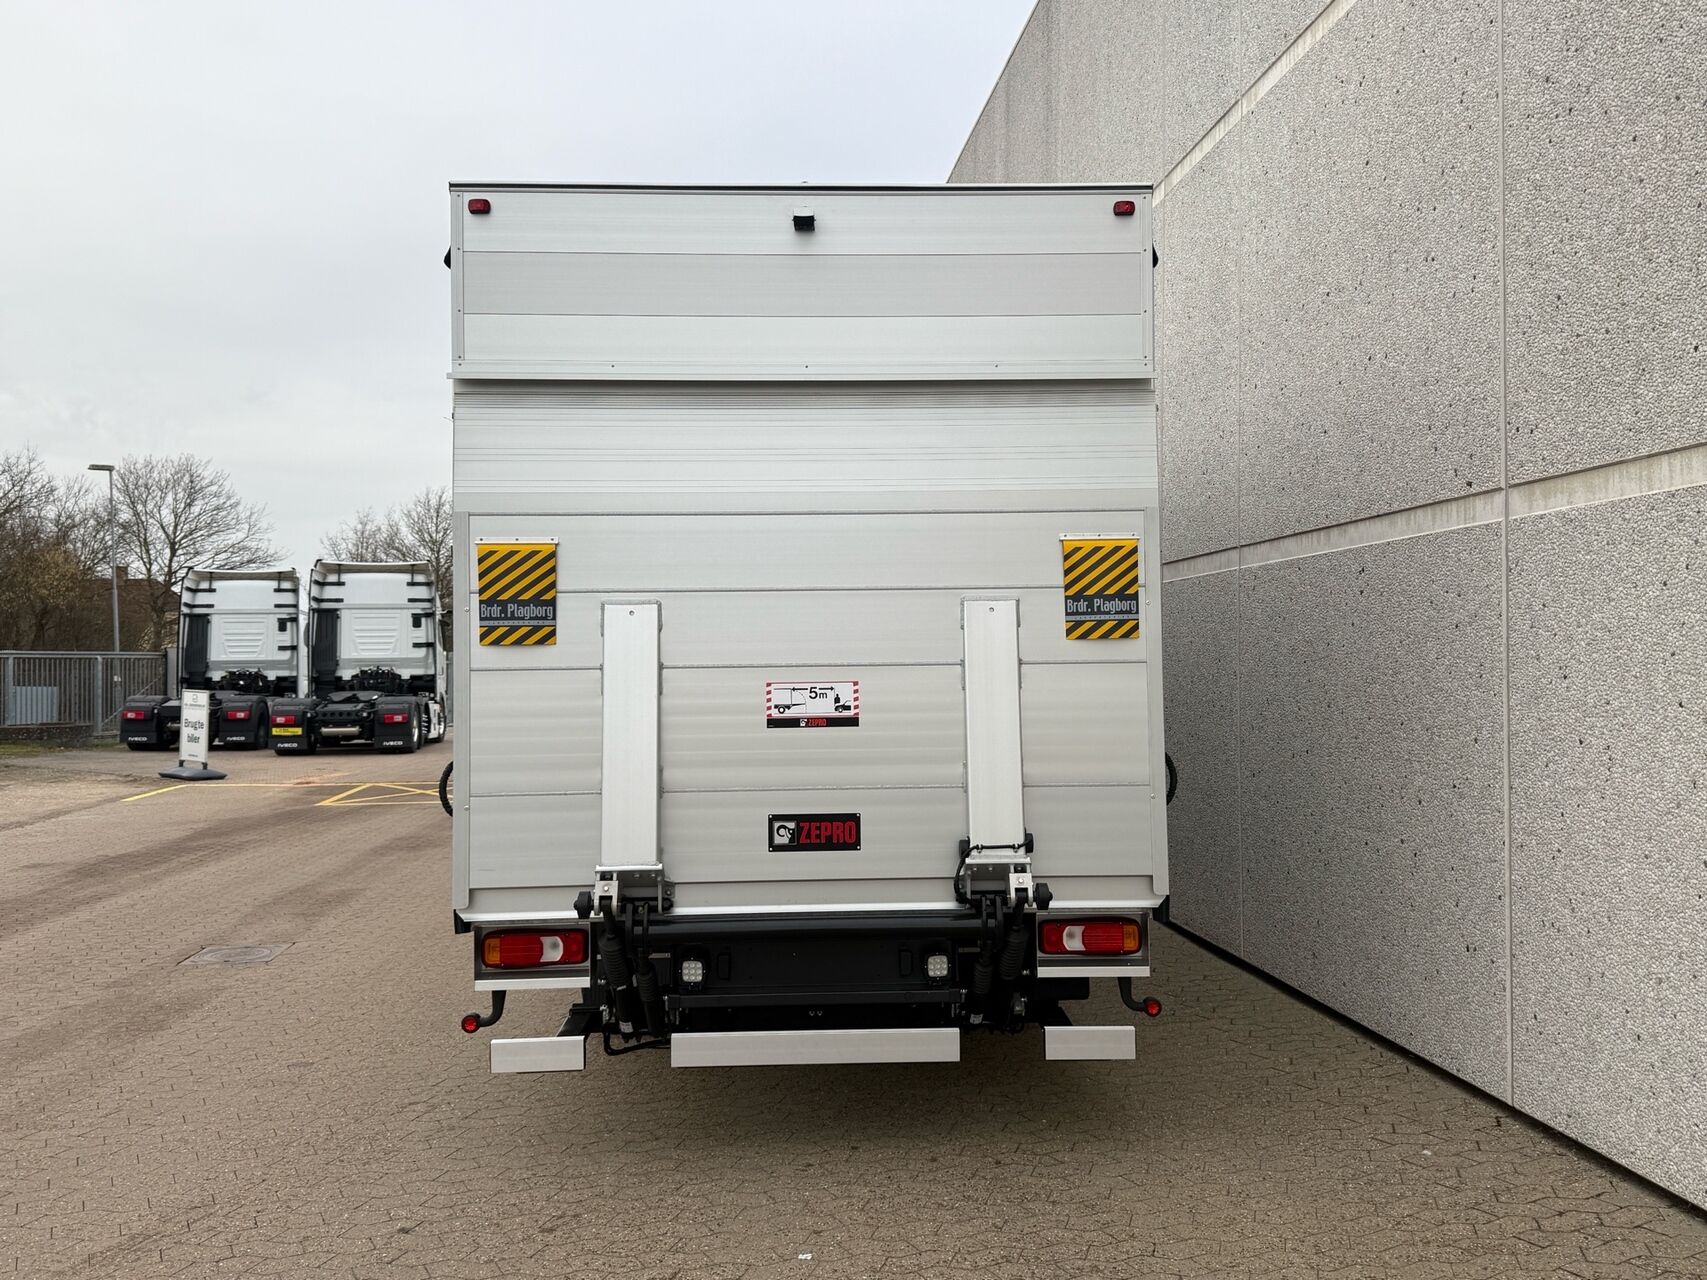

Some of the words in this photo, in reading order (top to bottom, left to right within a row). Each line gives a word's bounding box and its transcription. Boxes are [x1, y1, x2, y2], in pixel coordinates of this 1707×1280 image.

[480, 604, 505, 618] Brdr.
[507, 603, 553, 619] Plagborg
[1067, 598, 1091, 613] Brdr.
[1094, 598, 1137, 614] Plagborg
[184, 718, 205, 731] Brugte
[808, 718, 827, 726] ZEPRO
[187, 733, 200, 743] biler
[799, 820, 857, 844] ZEPRO
